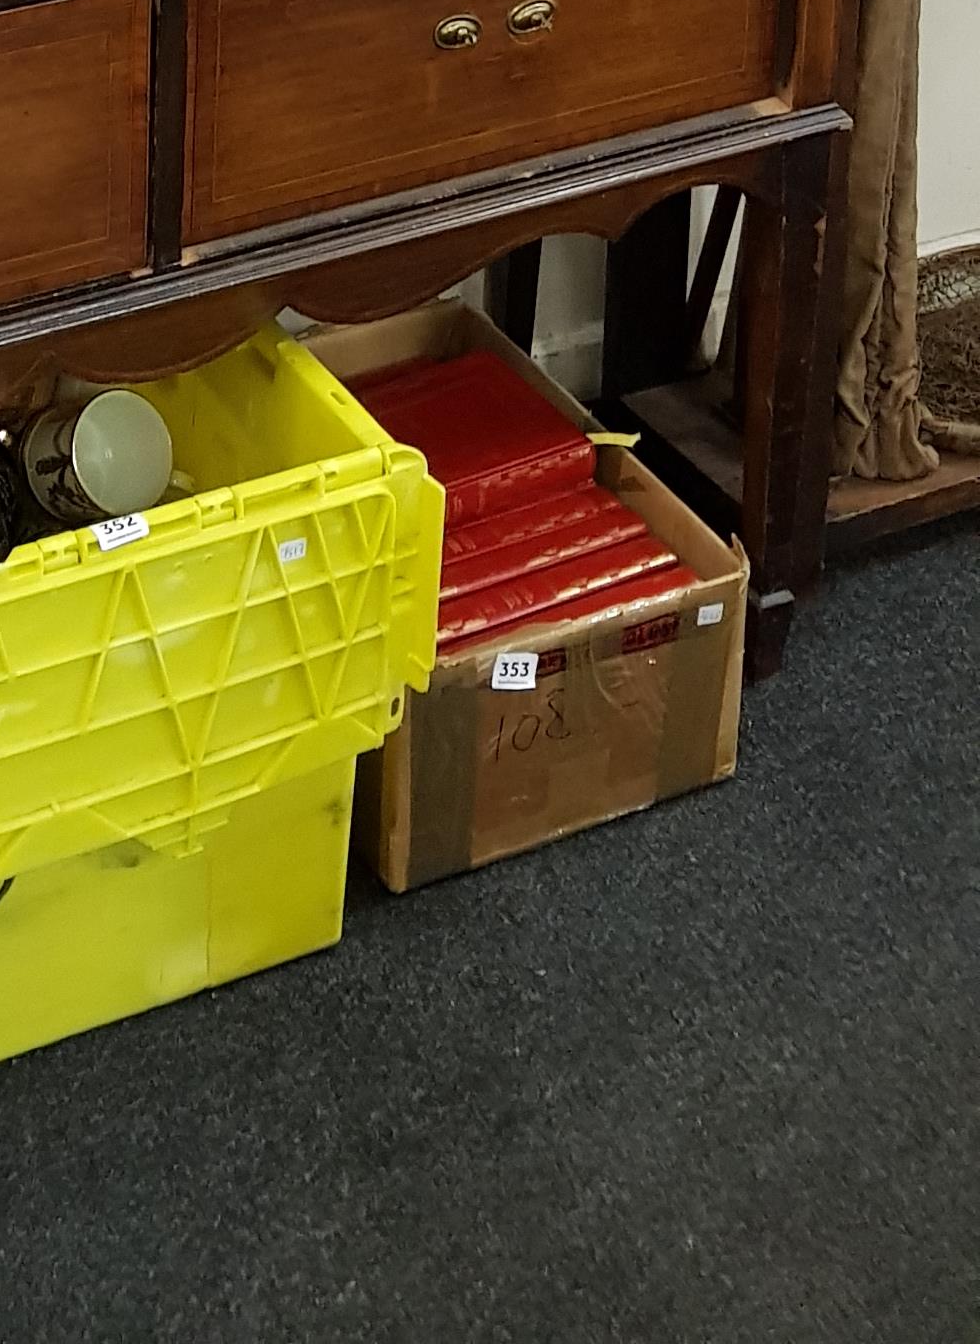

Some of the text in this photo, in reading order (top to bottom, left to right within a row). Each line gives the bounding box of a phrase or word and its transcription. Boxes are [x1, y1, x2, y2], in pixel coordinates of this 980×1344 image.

[100, 515, 138, 535] 352
[499, 662, 531, 678] 353
[495, 688, 570, 762] 108
